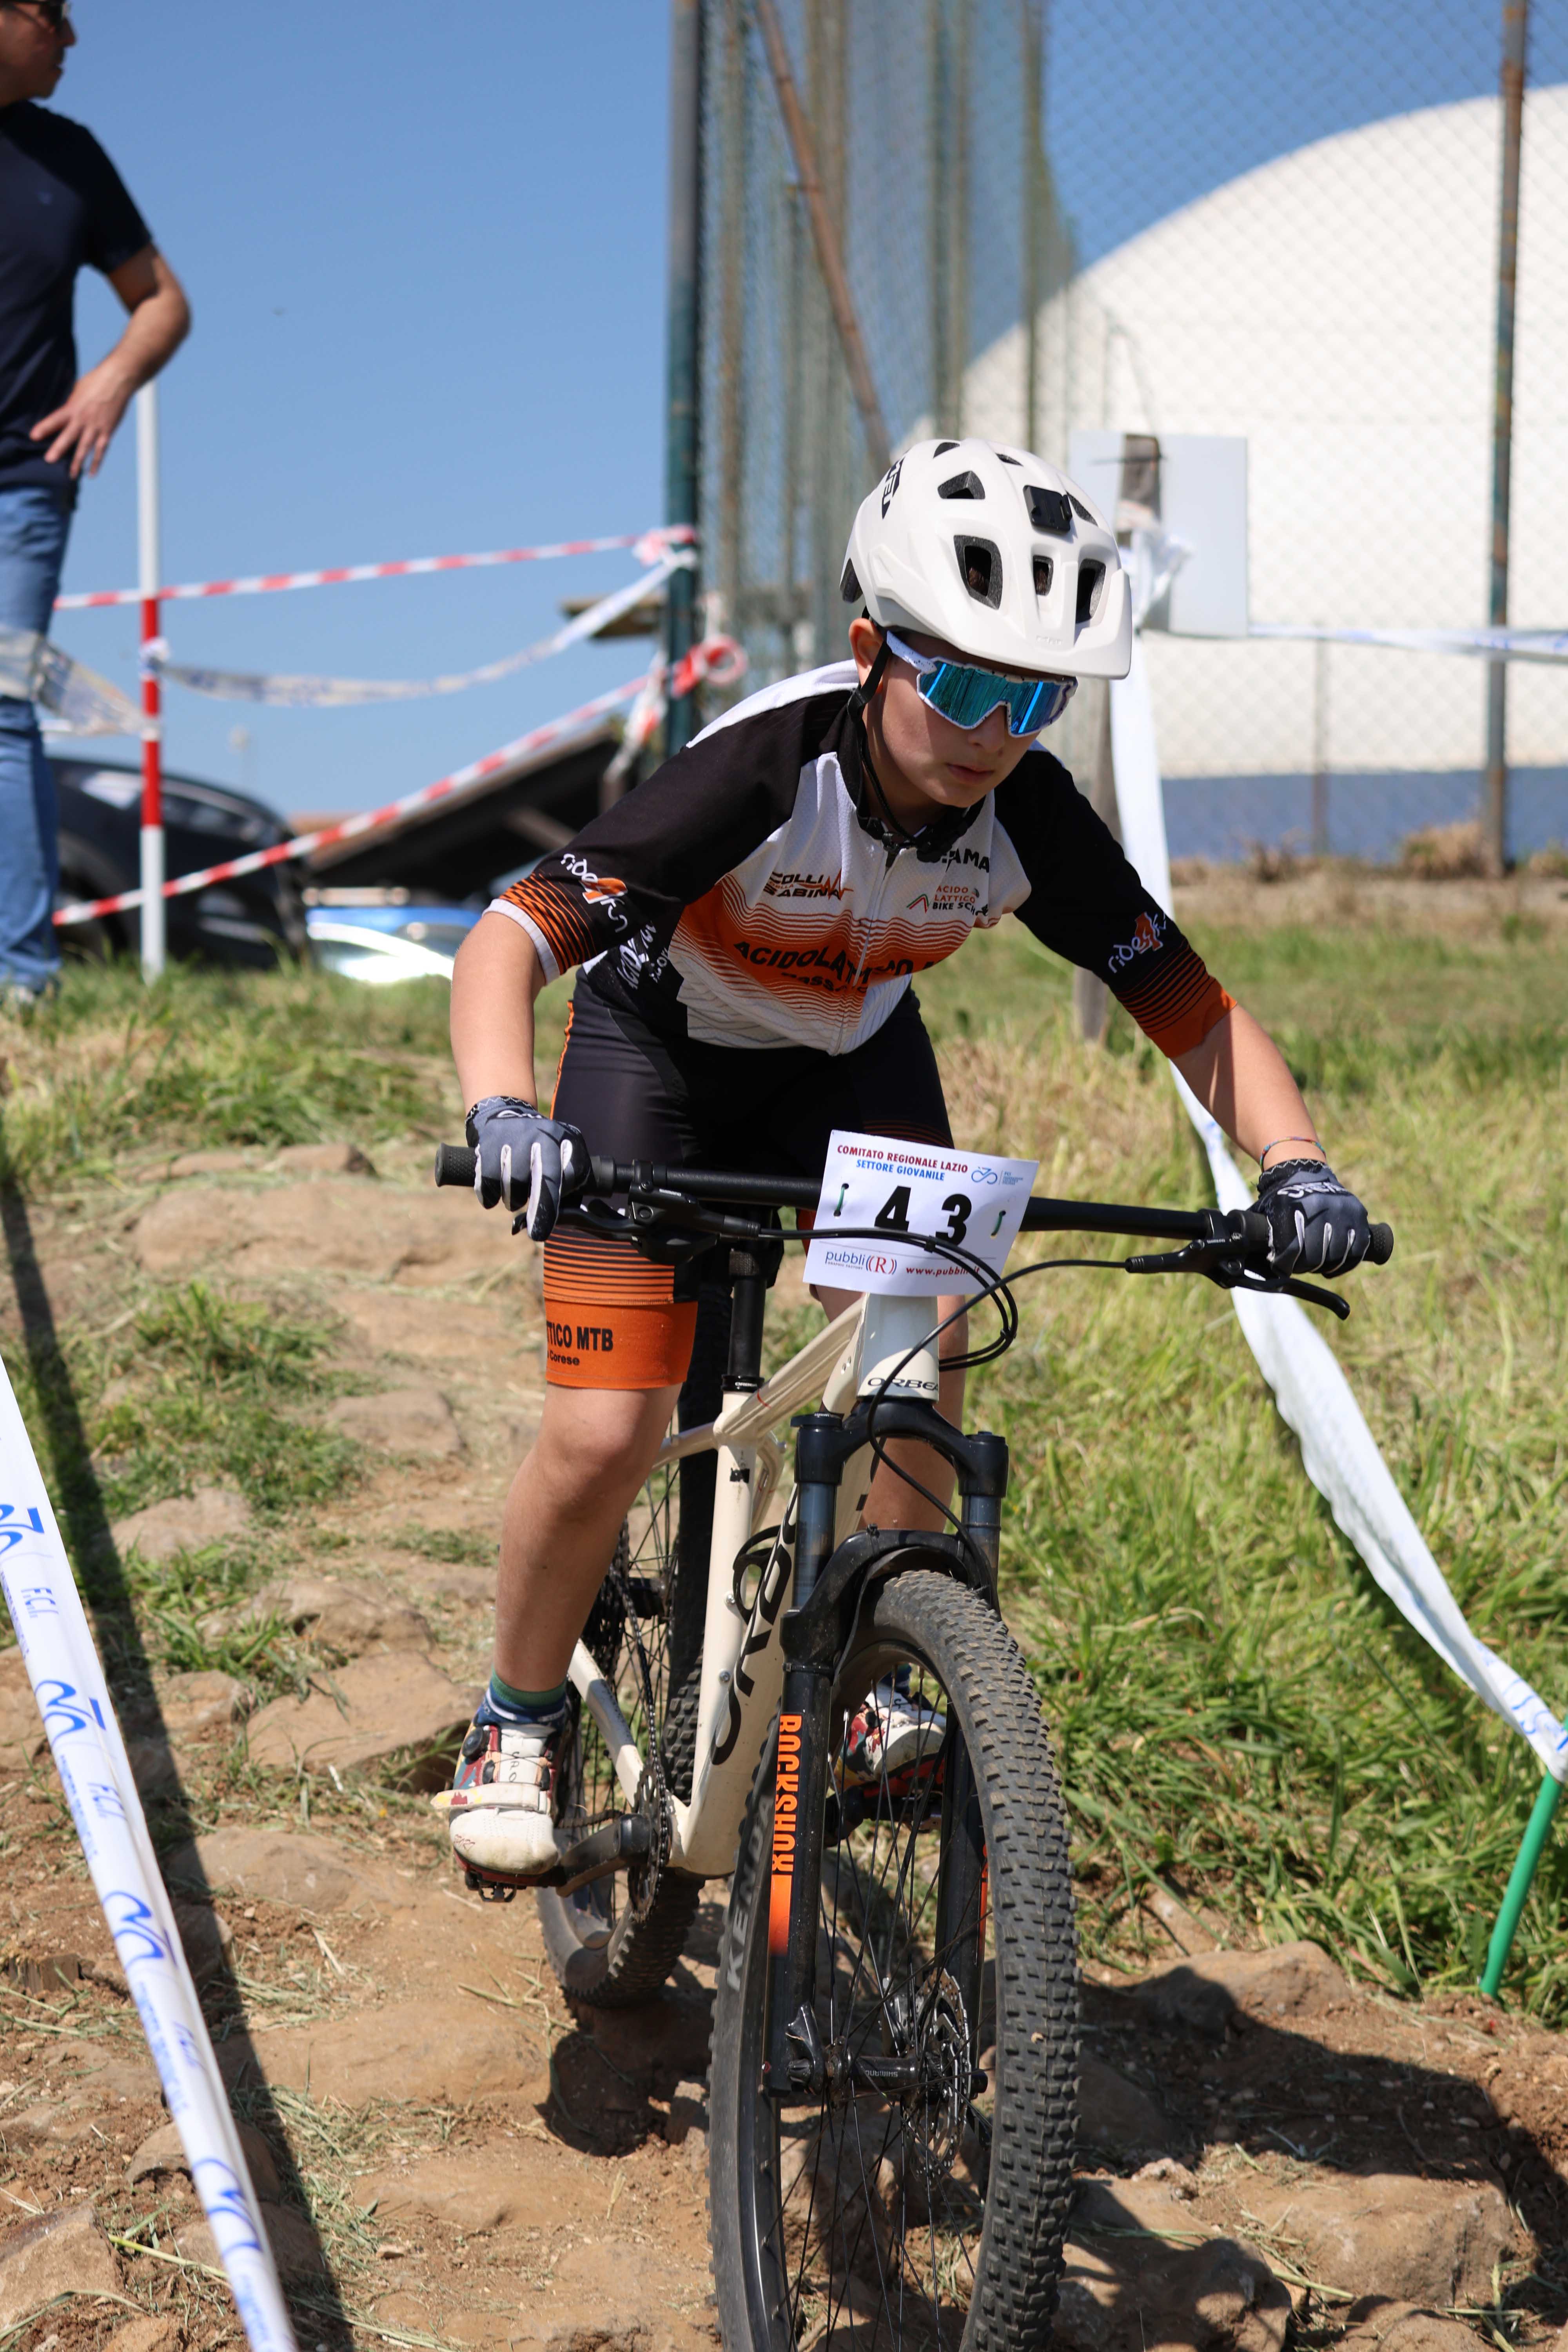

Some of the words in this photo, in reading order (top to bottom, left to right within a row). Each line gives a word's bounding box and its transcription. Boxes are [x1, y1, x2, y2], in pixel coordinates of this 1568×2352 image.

[935, 895, 975, 904] LATTICO
[936, 885, 969, 893] ACIDO
[837, 1145, 884, 1160] COMITATO
[887, 1152, 938, 1168] REGIONALE
[940, 1160, 968, 1173] LAZIO
[856, 1159, 893, 1172] SETTORE
[897, 1165, 945, 1181] GIOVANILE
[659, 1188, 681, 1197] SHIMANO
[577, 1326, 613, 1352] MTB
[550, 1350, 580, 1366] Corese
[772, 1715, 802, 1872] ROCKSHOX
[727, 1792, 773, 1992] KENDA
